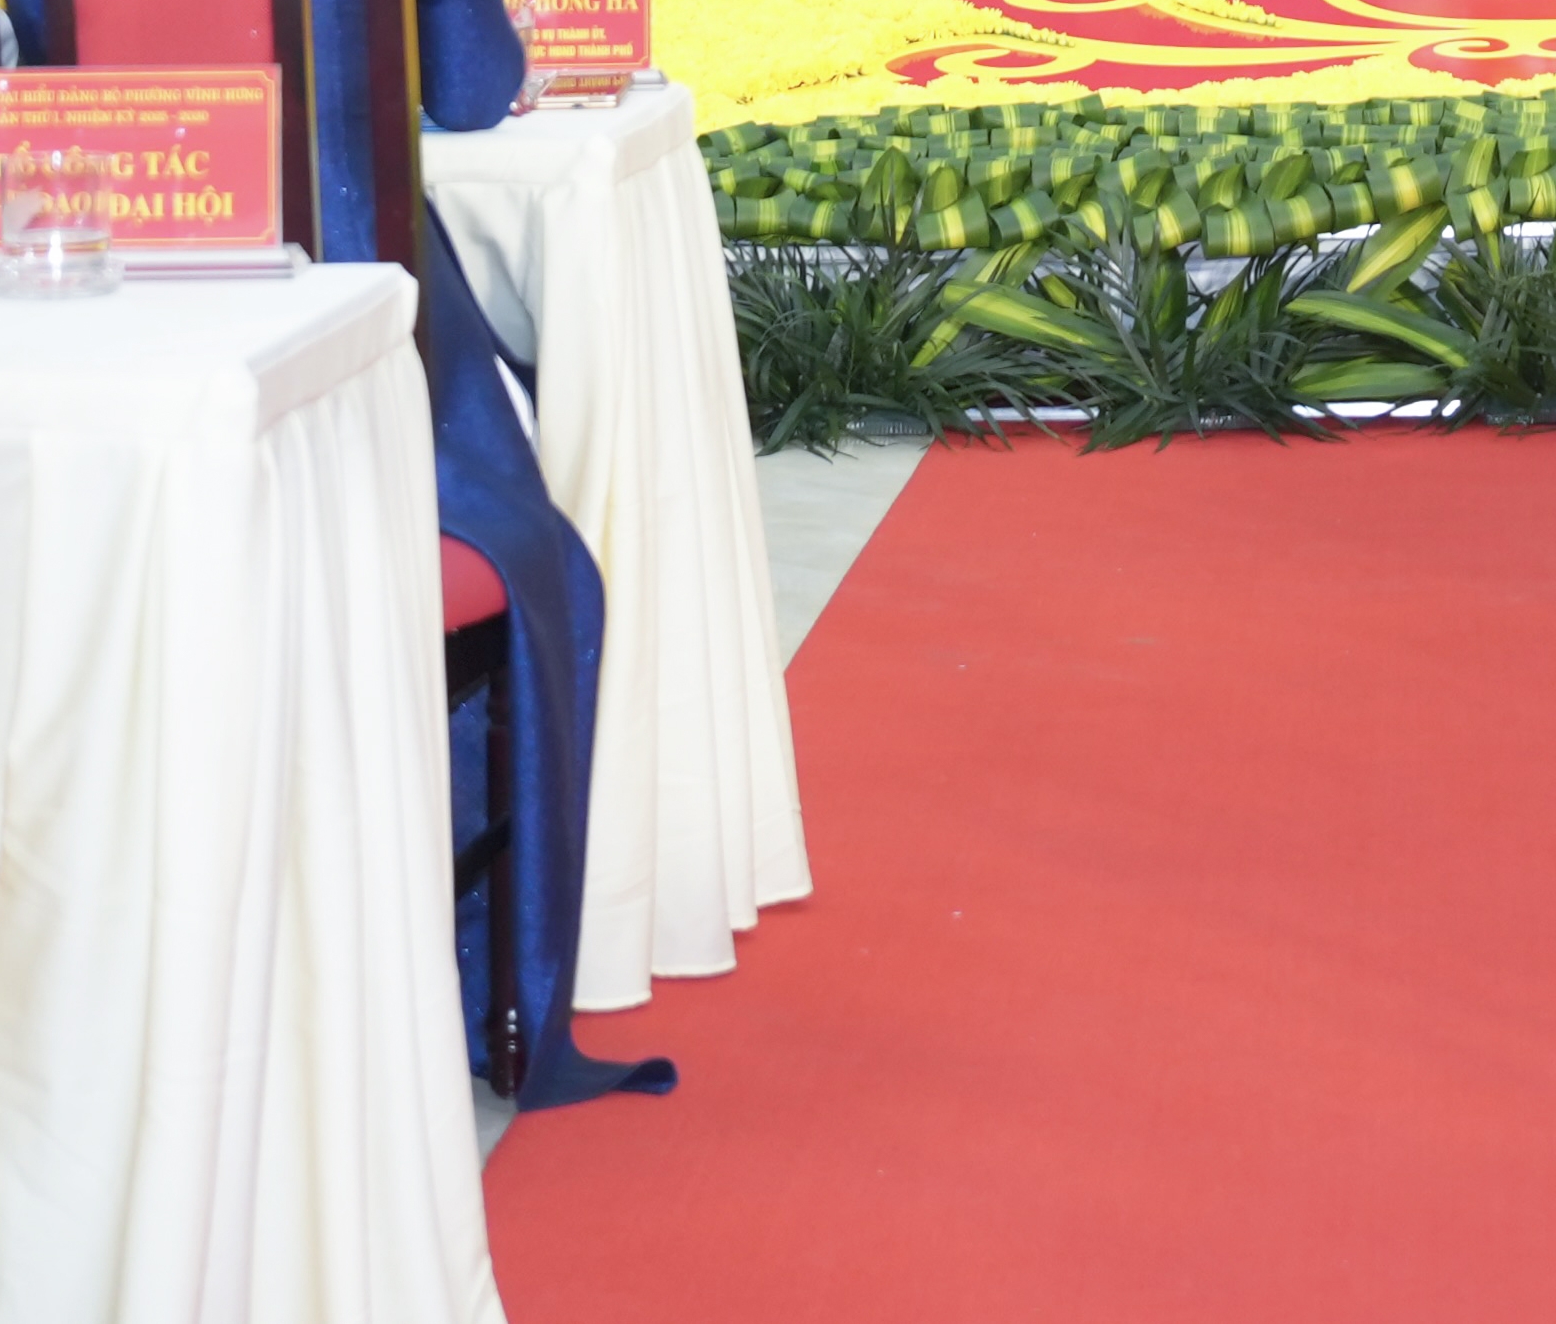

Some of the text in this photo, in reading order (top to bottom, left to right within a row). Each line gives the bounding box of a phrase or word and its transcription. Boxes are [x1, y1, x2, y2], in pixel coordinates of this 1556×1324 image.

[140, 142, 212, 180] TÁC
[108, 184, 235, 227] ĐẠI HỘI
